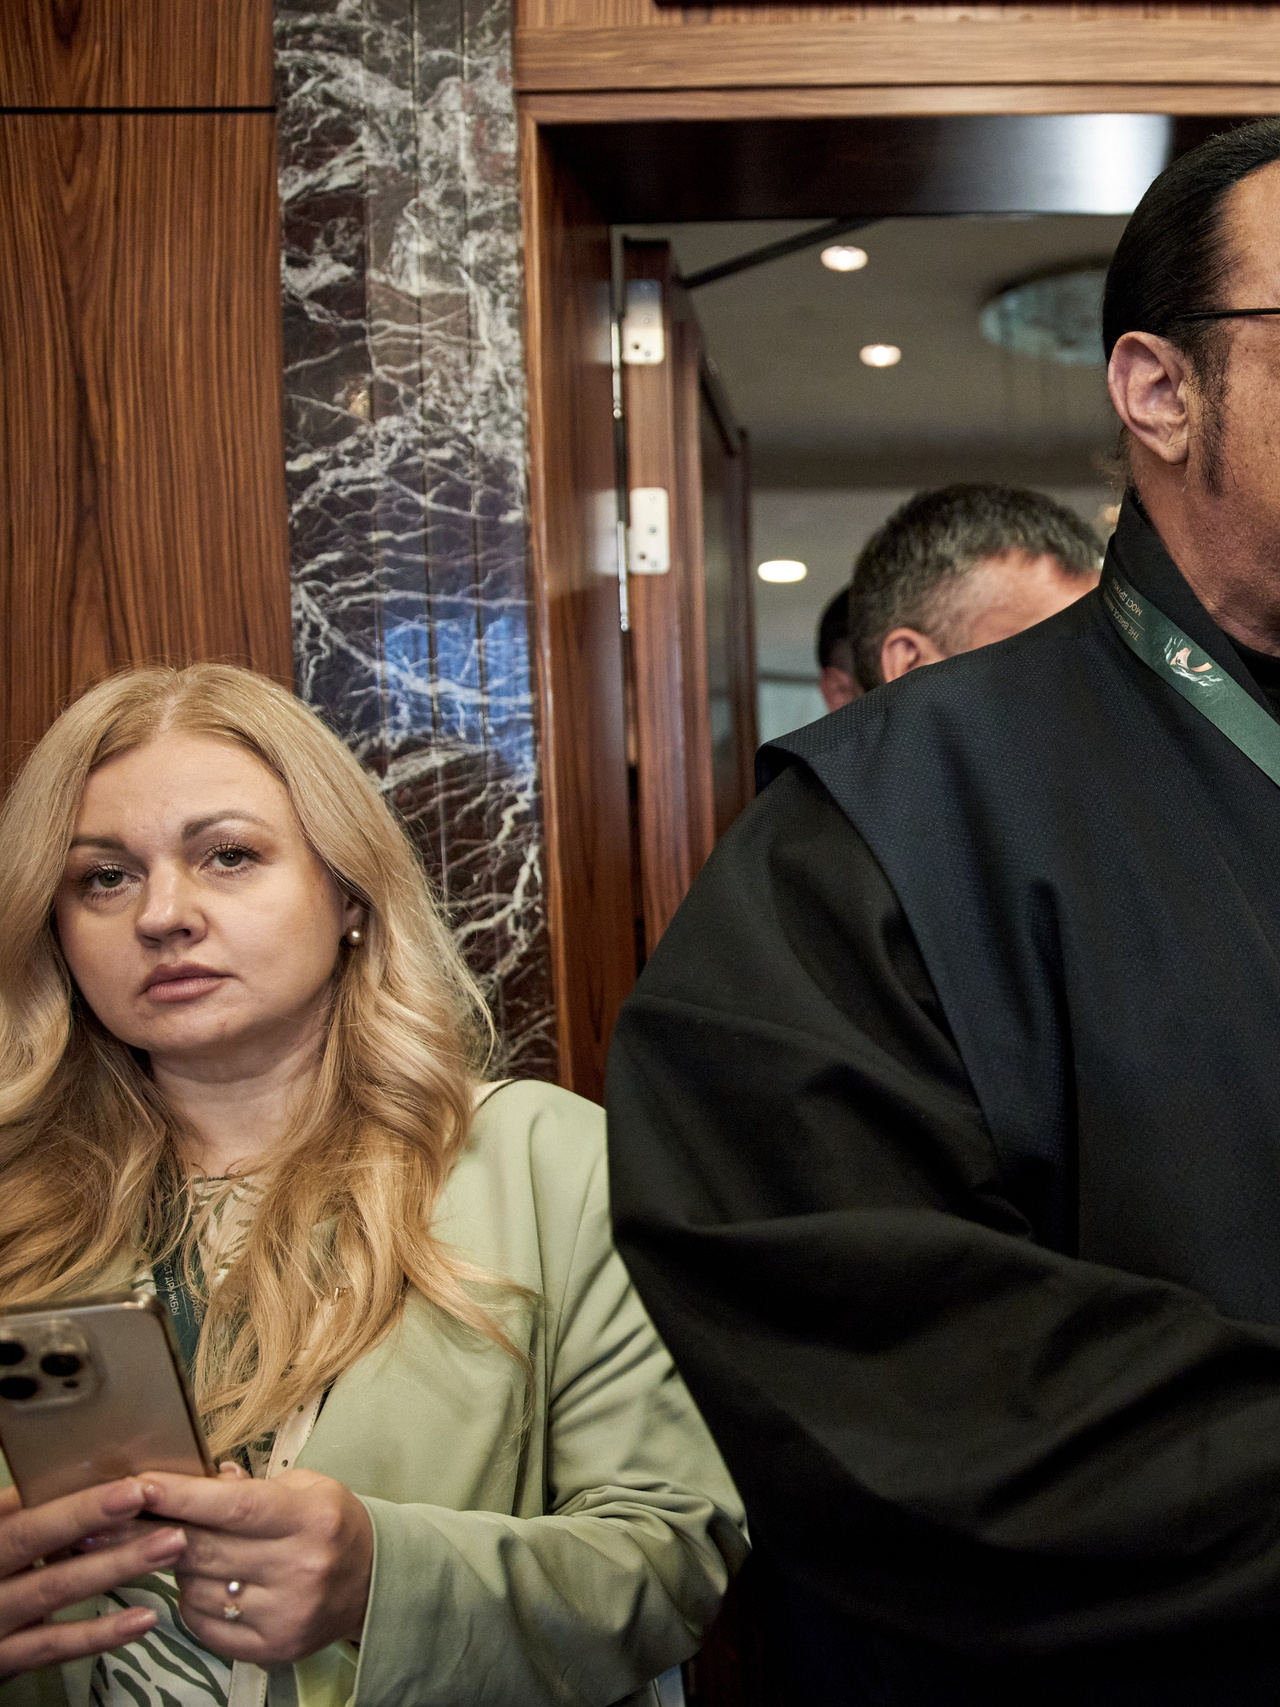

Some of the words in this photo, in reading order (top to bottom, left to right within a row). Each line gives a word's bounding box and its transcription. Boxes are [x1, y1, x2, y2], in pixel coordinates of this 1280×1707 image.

[1128, 625, 1139, 641] THE
[162, 1258, 173, 1277] ОСТ
[164, 1276, 181, 1317] ДРУЖБЫ
